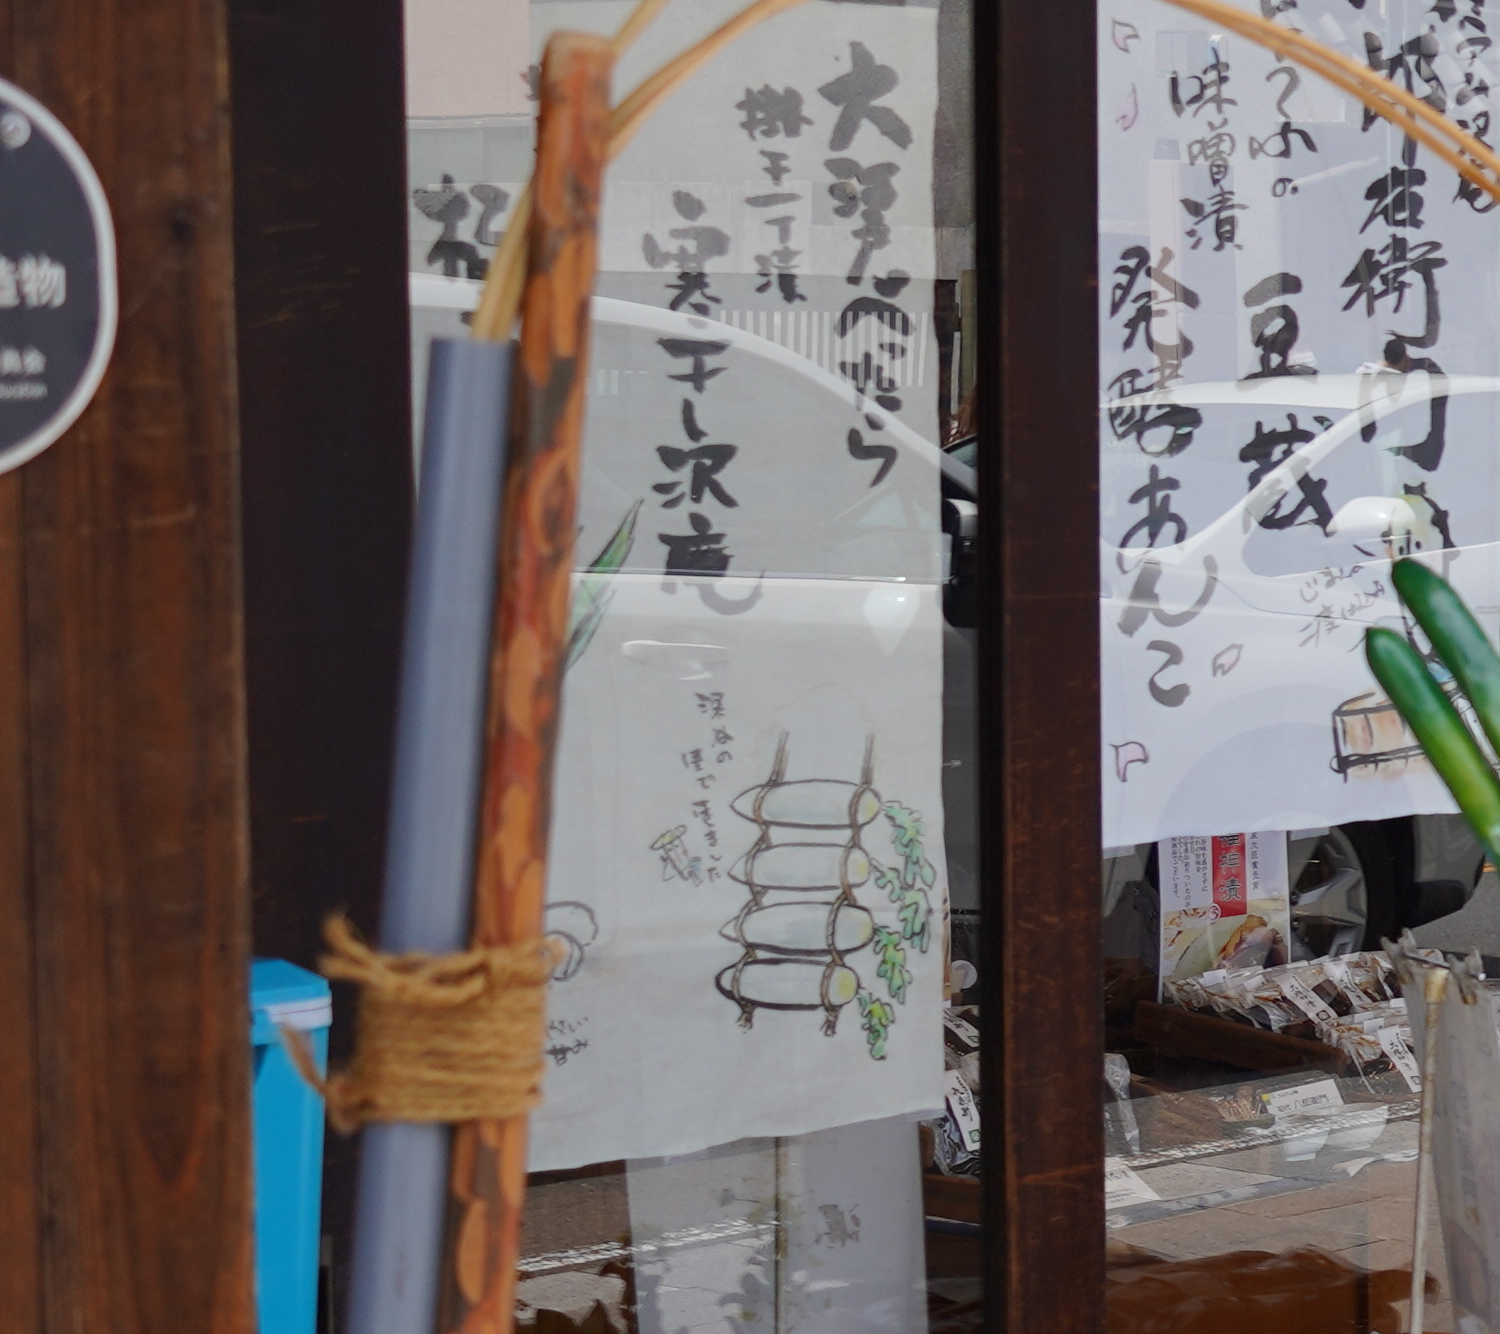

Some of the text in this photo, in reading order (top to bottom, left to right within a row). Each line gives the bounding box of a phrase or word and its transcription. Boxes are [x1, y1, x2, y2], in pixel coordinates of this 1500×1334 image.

[1169, 50, 1249, 253] 味噌漬
[1107, 245, 1218, 708] 発酵あんこ
[1236, 271, 1336, 538] 豆蔵
